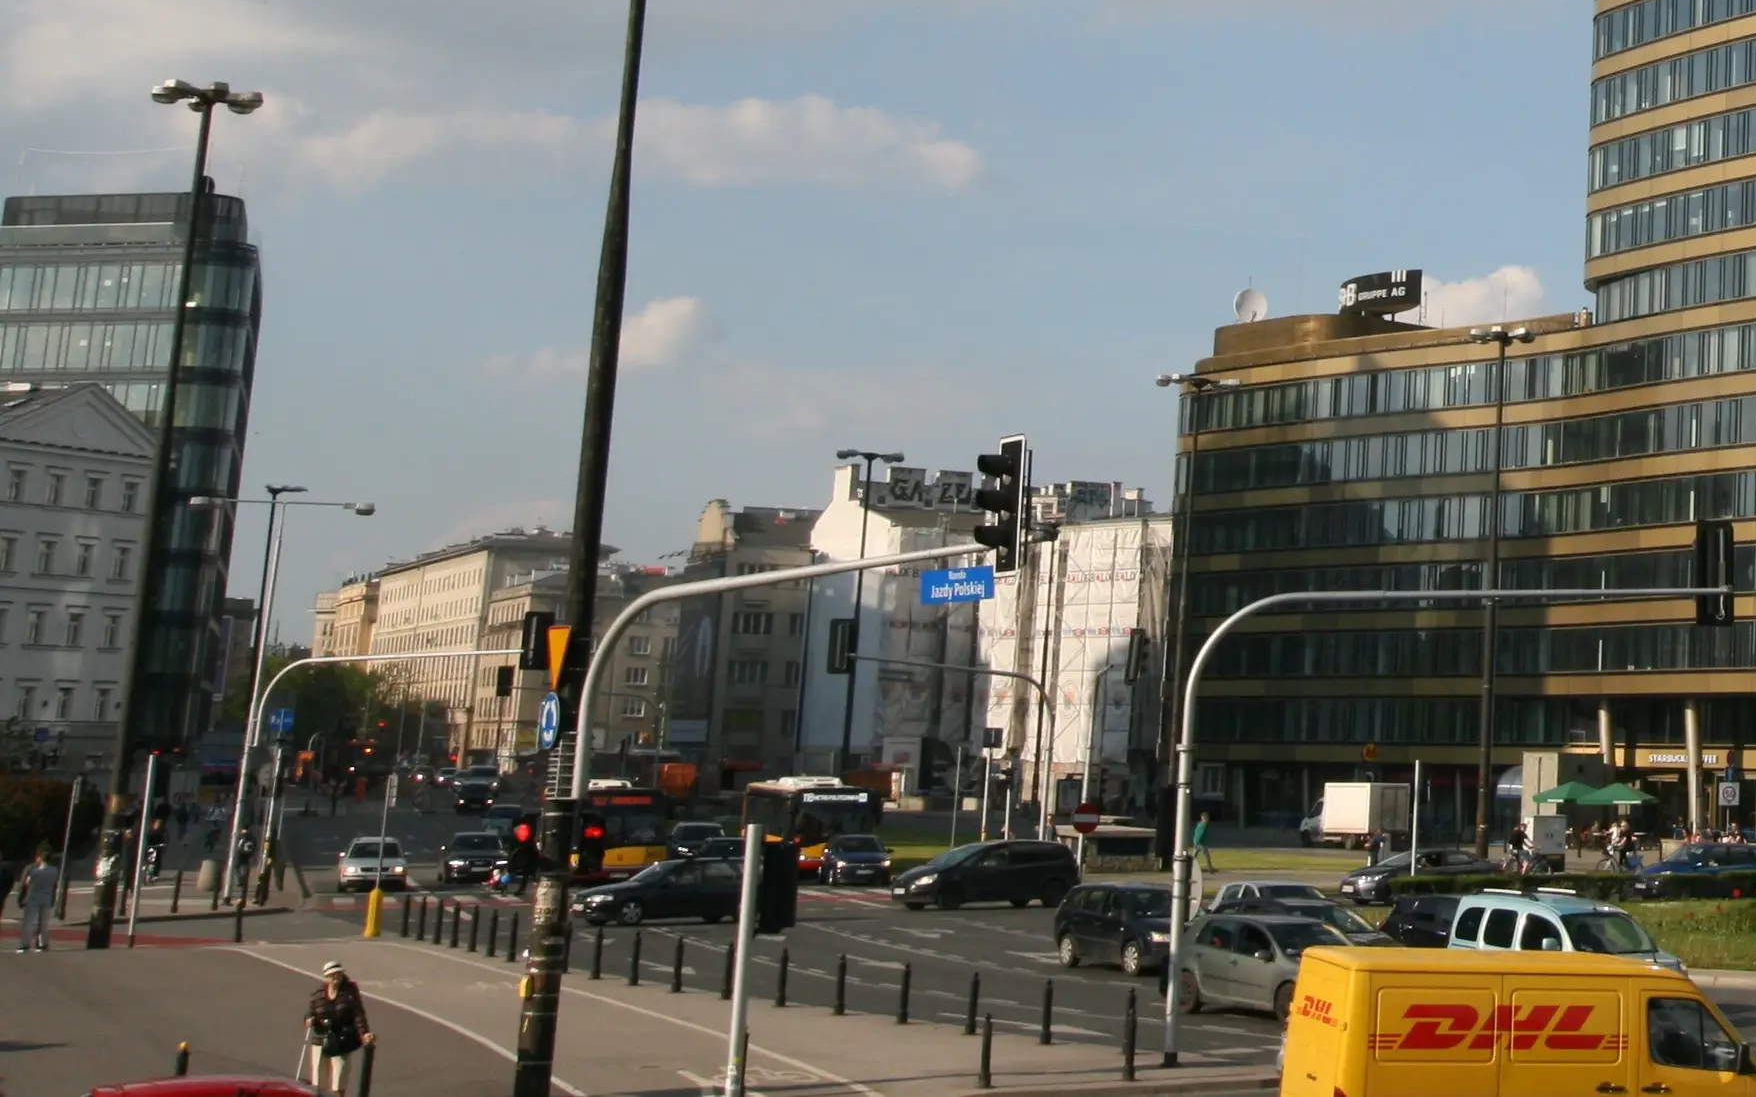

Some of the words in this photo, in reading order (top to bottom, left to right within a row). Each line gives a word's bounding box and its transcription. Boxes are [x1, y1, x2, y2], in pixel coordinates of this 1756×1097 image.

[1358, 289, 1388, 300] GRUPPE
[1391, 286, 1406, 297] AG
[948, 570, 967, 580] Rondo
[931, 584, 953, 600] Jazdy
[954, 580, 985, 598] Polskiej
[1302, 995, 1333, 1024] DHL
[1397, 1004, 1606, 1050] DHL
